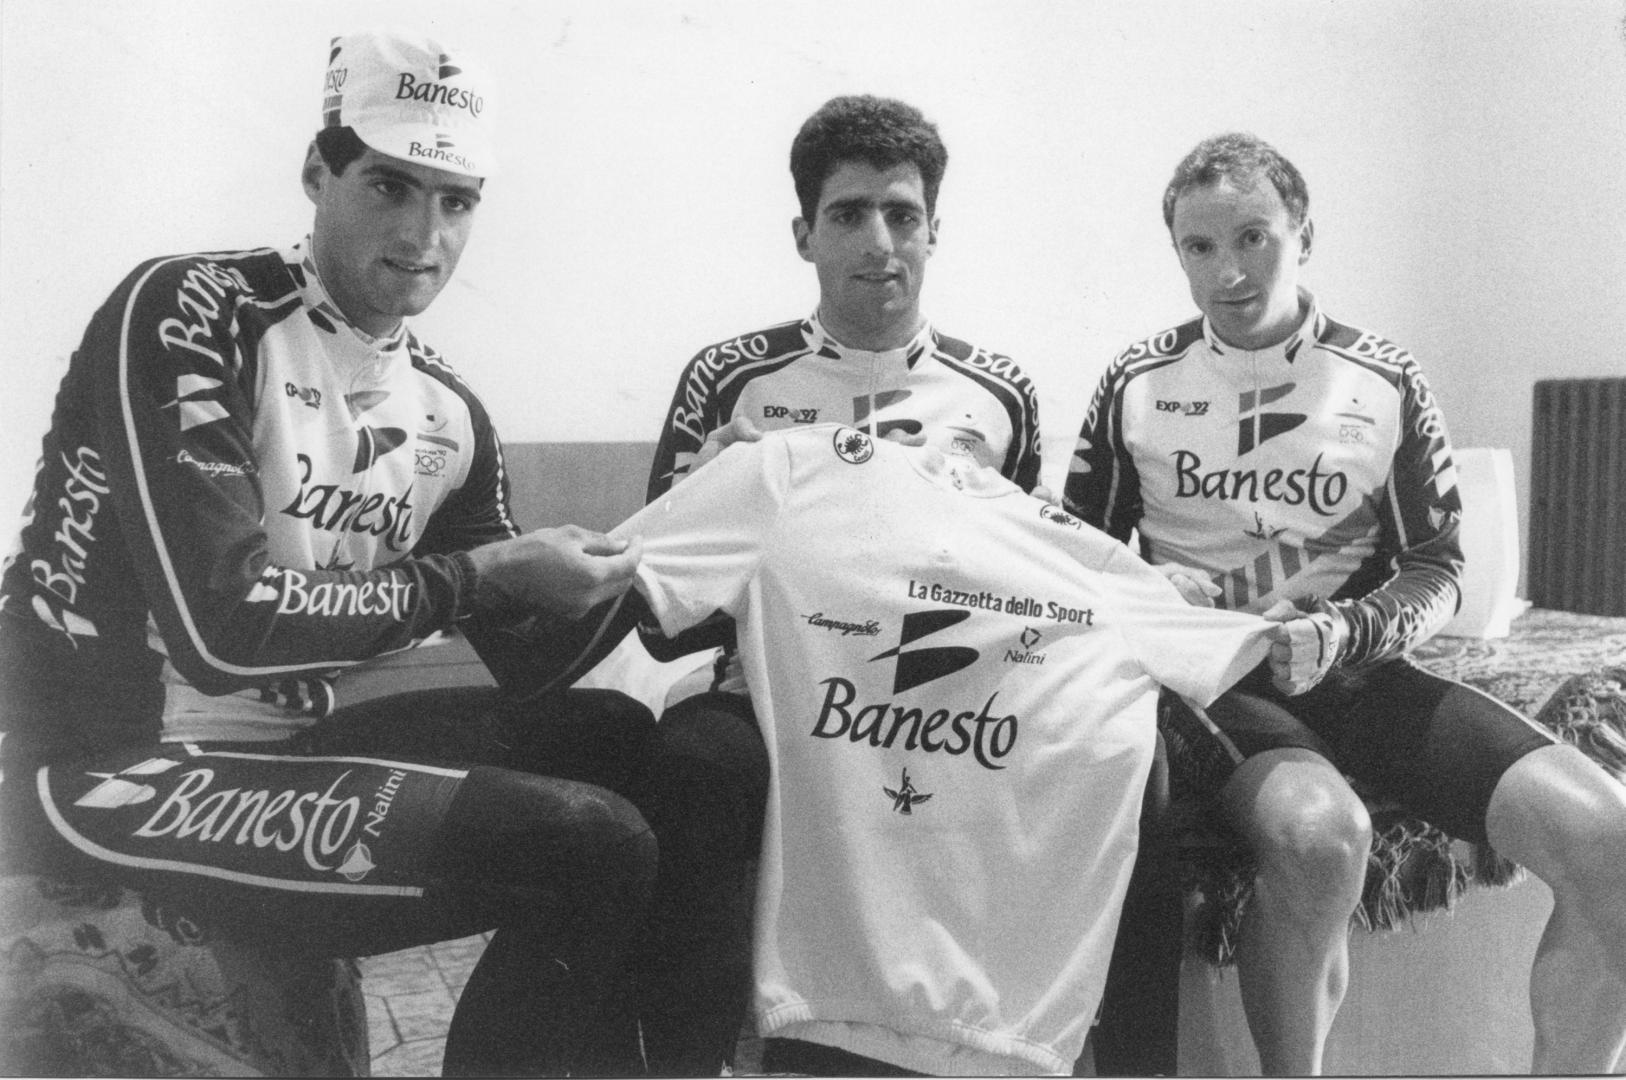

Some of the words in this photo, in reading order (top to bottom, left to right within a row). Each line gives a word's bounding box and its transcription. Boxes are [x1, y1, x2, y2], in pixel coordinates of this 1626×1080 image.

[395, 72, 484, 118] Banesto
[408, 141, 476, 169] Banesto
[673, 334, 768, 444] Banesto
[1169, 449, 1348, 517] Banesto
[31, 446, 110, 604] Banesto
[908, 580, 928, 600] La
[930, 583, 1003, 612] Gazzetta
[1004, 596, 1043, 618] dello
[1046, 601, 1095, 627] Sport
[1003, 649, 1047, 666] Nalini
[810, 676, 1018, 771] Banesto
[132, 768, 361, 871] Banesto
[363, 768, 409, 838] Nalini
